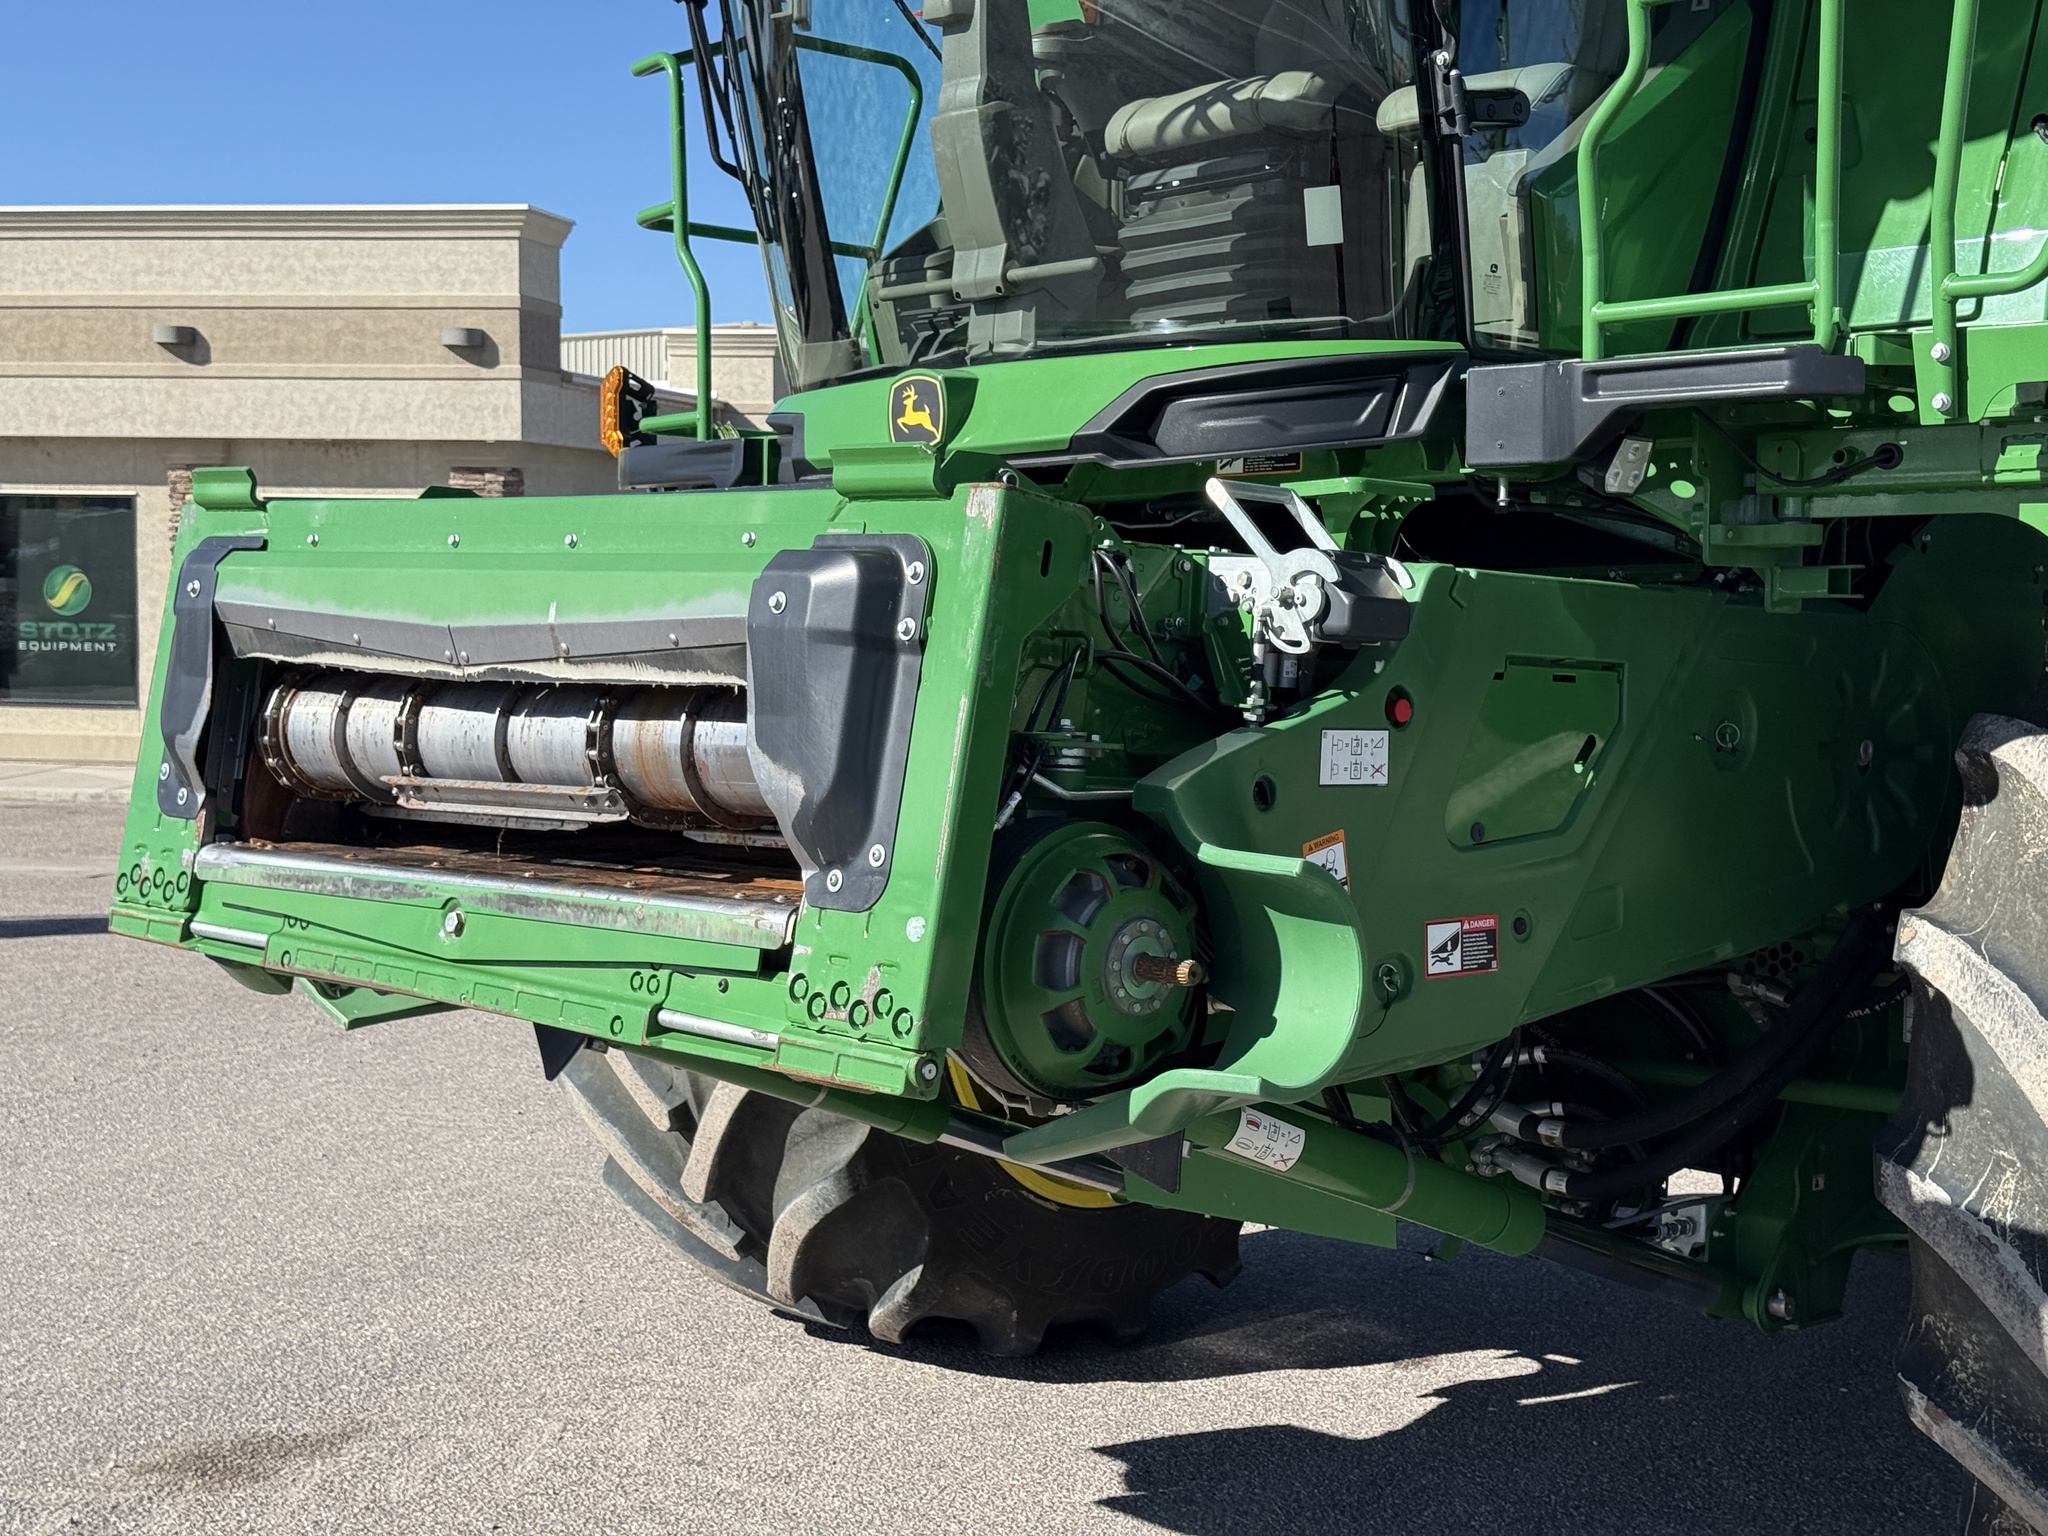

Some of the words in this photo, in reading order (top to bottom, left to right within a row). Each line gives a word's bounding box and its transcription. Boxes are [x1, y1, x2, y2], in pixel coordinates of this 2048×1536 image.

[19, 621, 116, 639] STOTZ
[18, 640, 117, 651] EQUIPMENT
[1313, 833, 1340, 849] WARNING
[1469, 918, 1495, 929] DANGER
